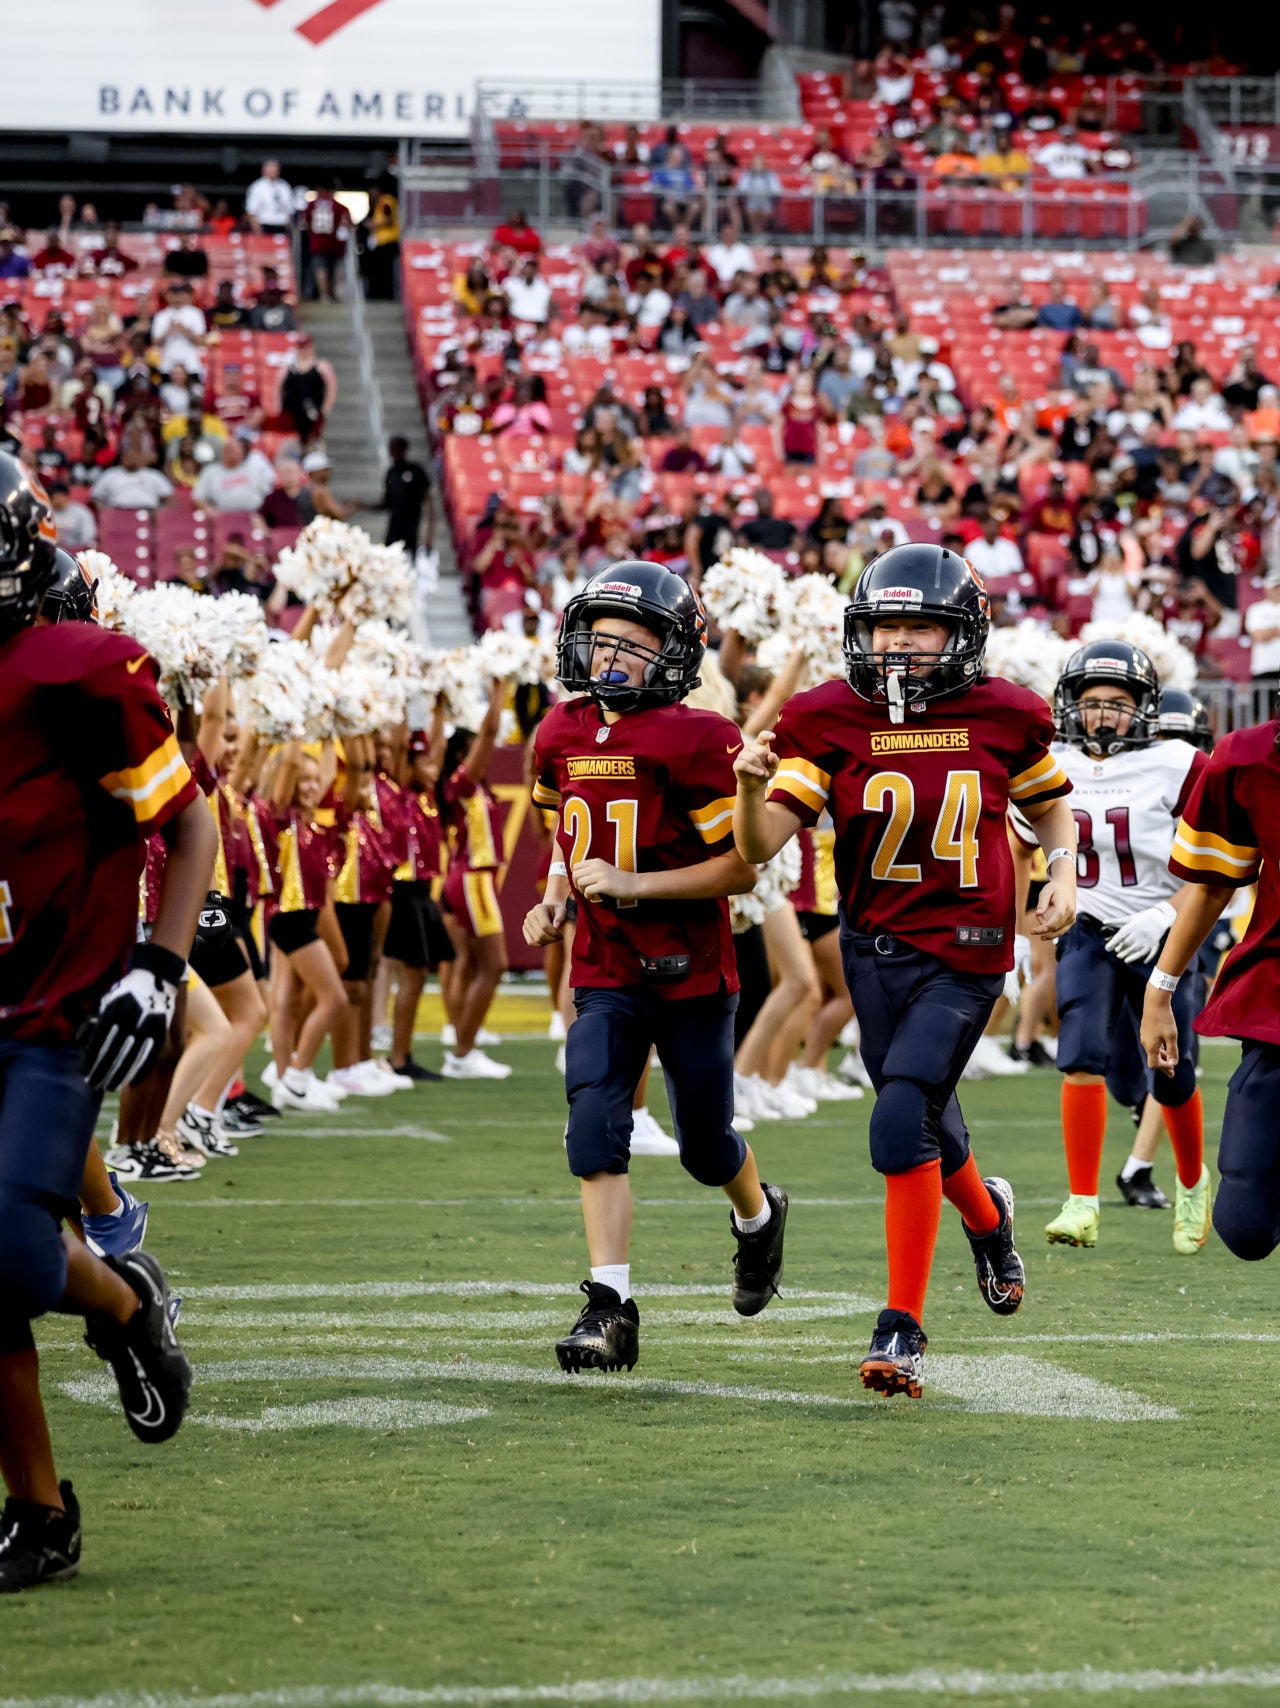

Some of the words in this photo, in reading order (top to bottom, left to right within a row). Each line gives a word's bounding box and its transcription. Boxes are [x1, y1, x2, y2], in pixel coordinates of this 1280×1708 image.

[98, 86, 226, 116] BANK
[243, 90, 298, 118] OF
[315, 92, 529, 121] AMERIA
[603, 583, 632, 593] Riddell
[883, 589, 912, 598] Riddell
[871, 732, 970, 751] COMMANDERS
[566, 760, 636, 777] COMMANDERS
[863, 770, 982, 888] 24
[563, 796, 639, 909] 21
